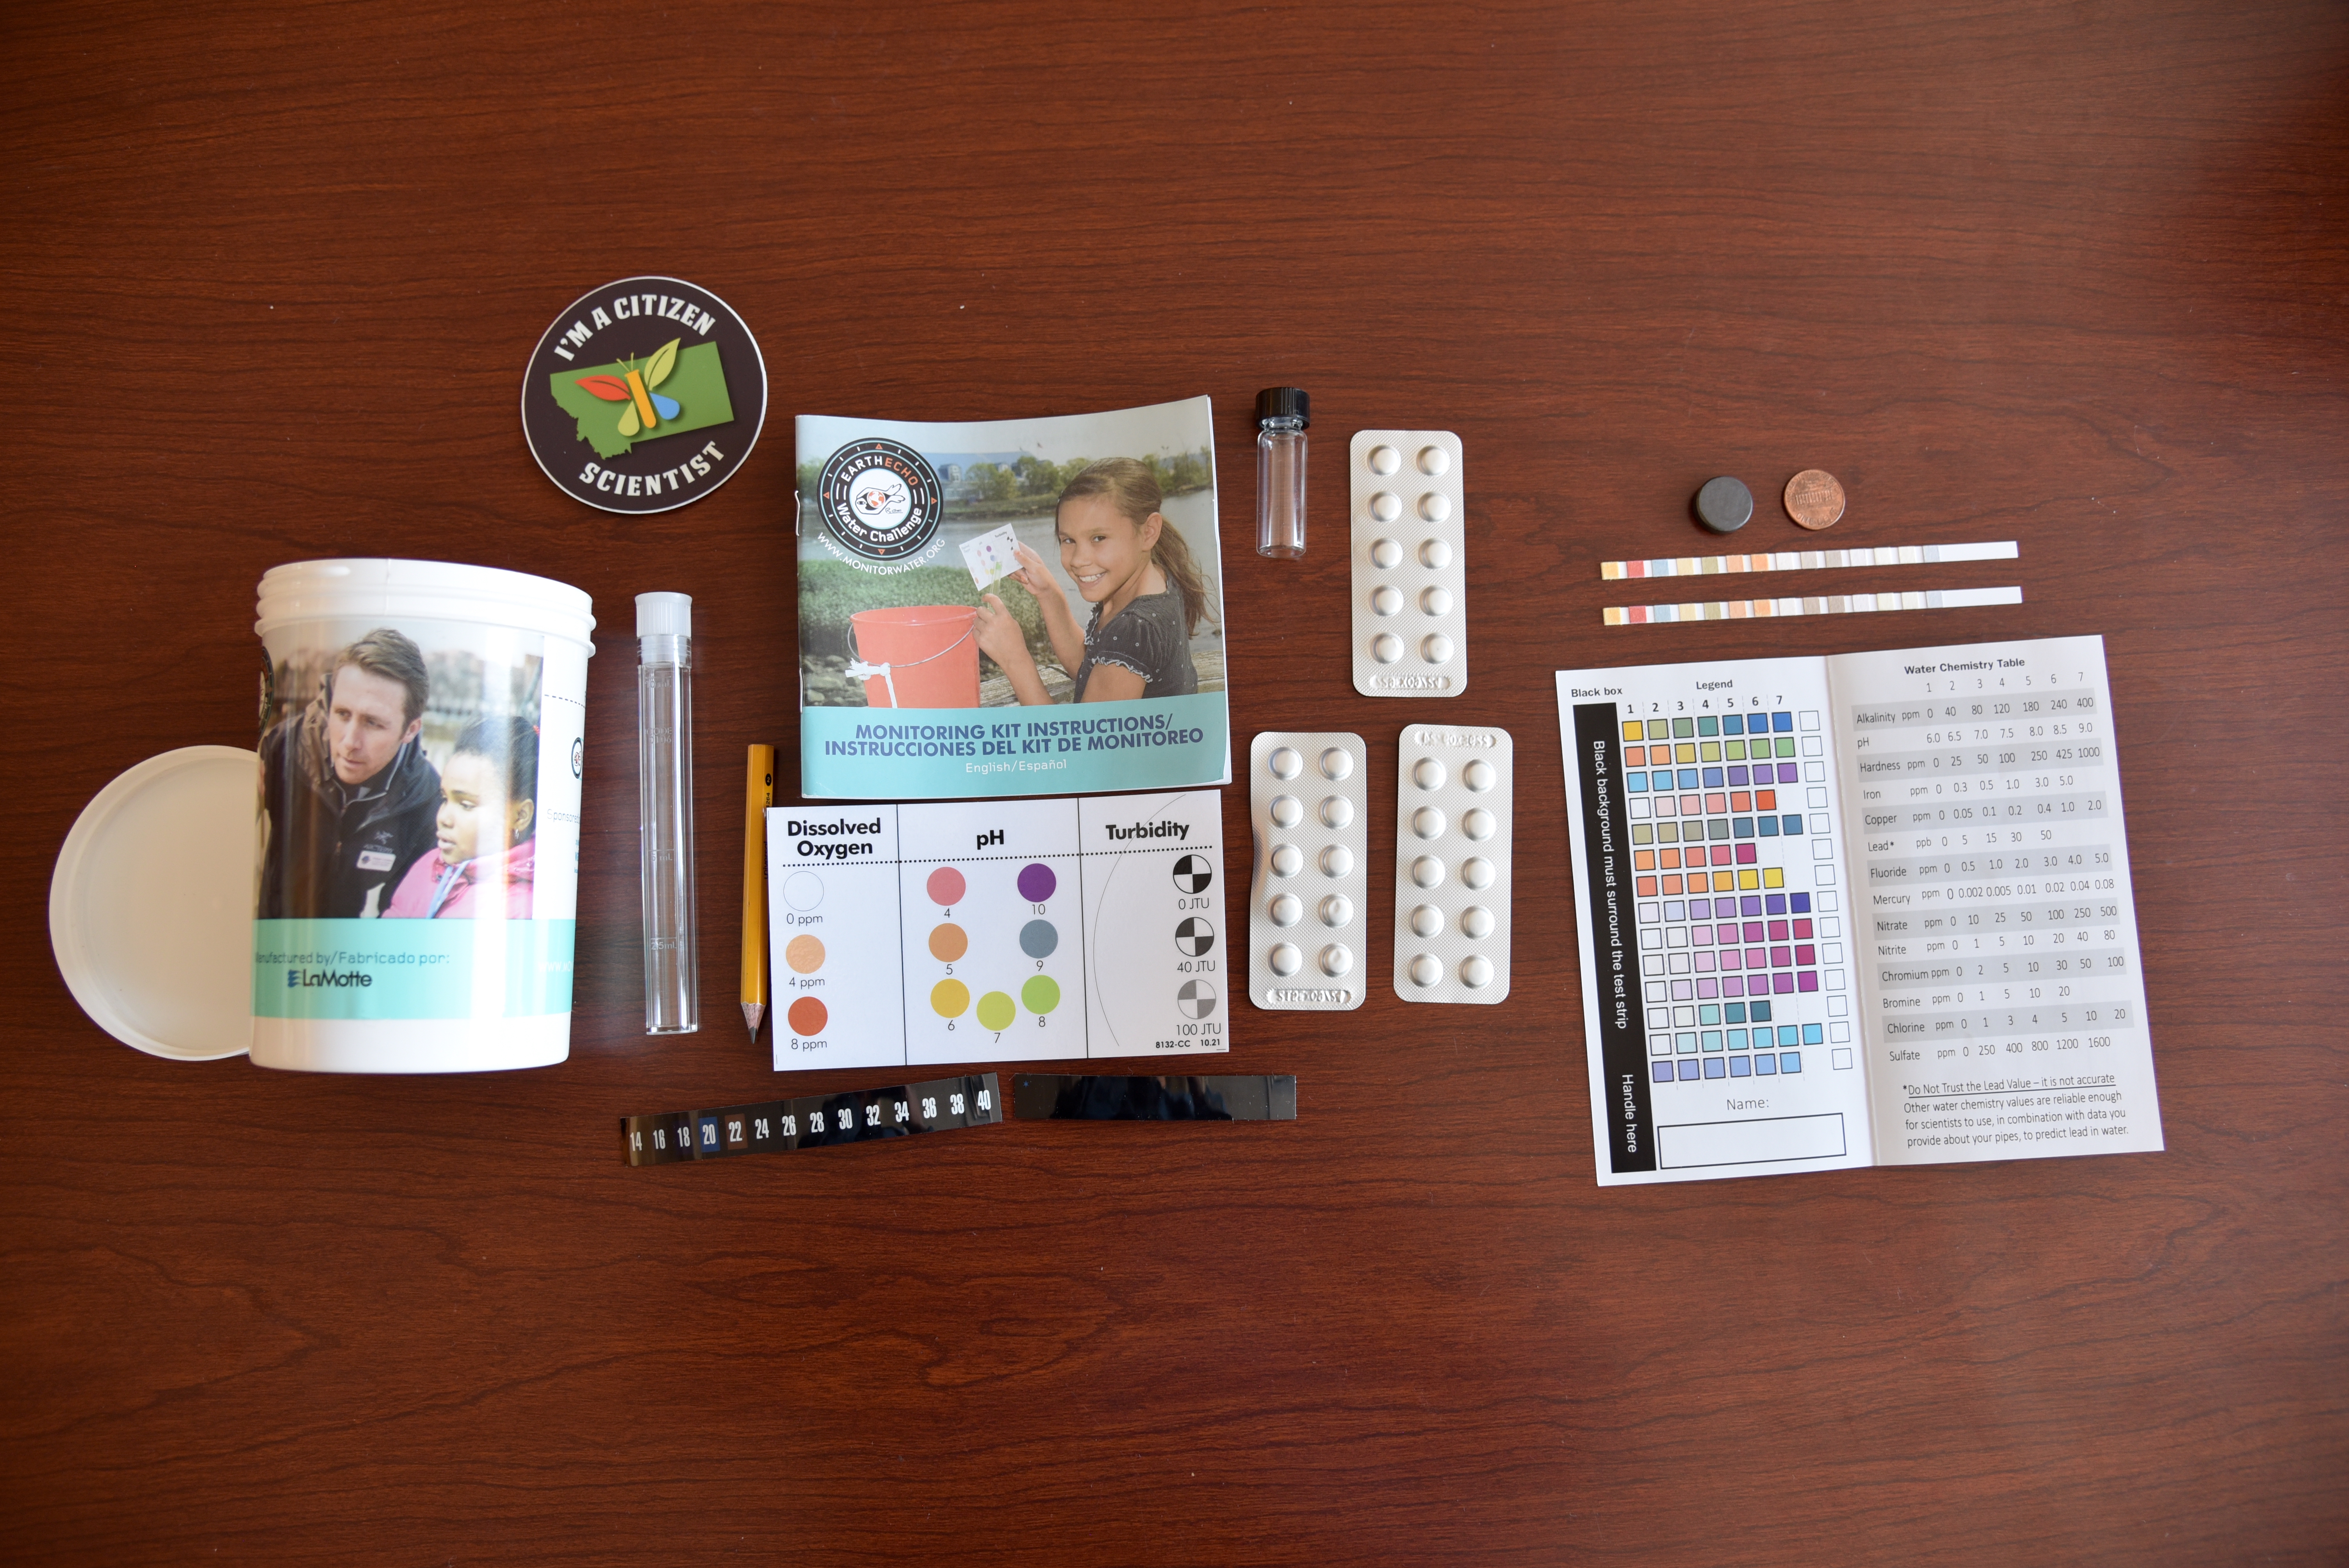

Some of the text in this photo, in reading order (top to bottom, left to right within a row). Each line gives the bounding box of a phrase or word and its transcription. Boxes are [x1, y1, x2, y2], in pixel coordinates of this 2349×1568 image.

[554, 294, 716, 361] I'M A CITIZEN
[579, 441, 724, 497] SCIENTIST
[836, 502, 922, 542] Water Challenge
[818, 532, 945, 576] WWW.MONITORWATER.ORG
[1904, 658, 2025, 674] Water Chemistry Table
[1571, 687, 1622, 697] Black box
[1696, 679, 1733, 691] Legend
[1627, 695, 1782, 714] 1 2 3 4 5 6 7
[1857, 697, 2094, 724] Alkalinity ppm 0 40 80 120 180 240 400
[855, 713, 1173, 740] MONITORING KIT INSTRUCTIONS/
[825, 728, 1204, 757] INSTRUCCIONES DEL KIT DE MONITOREO
[966, 759, 1066, 775] English/Español
[788, 817, 881, 836] Dissolved
[1105, 820, 1190, 841] Turbidity
[977, 829, 1004, 850] pH
[797, 840, 873, 860] Oxygen
[1594, 741, 1629, 1029] Black background must surround the test strip
[1873, 878, 2114, 905] Mercury ppm 0 0.002 0.005 0.01 0.02 0.04 0.08
[944, 908, 950, 918] 4
[1032, 903, 1046, 915] 10
[1178, 897, 1209, 910] 0 JTU
[786, 913, 823, 927] 0 ppm
[316, 951, 415, 966] by/Fabricado
[419, 954, 449, 967] por:
[1036, 960, 1043, 971] 9
[1177, 960, 1215, 973] 40 JTU
[302, 968, 372, 987] LaMotte
[946, 964, 953, 975] 5
[789, 976, 825, 990] 4 ppm
[948, 1019, 955, 1031] 6
[1039, 1016, 1046, 1027] 8
[1176, 1023, 1221, 1036] 100 JTU
[791, 1038, 827, 1052] 8 ppm
[994, 1032, 1001, 1044] 7
[1155, 1040, 1191, 1049] 8132-CC
[1923, 1084, 1940, 1094] Not
[1941, 1083, 1964, 1093] Trust
[1966, 1081, 1981, 1092] the
[1984, 1079, 2004, 1090] Lead
[2006, 1078, 2031, 1089] Value
[2041, 1077, 2048, 1087] it
[2050, 1076, 2057, 1087] is
[2059, 1076, 2075, 1086] not
[2077, 1074, 2115, 1085] accurate
[1727, 1099, 1769, 1110] Name:
[1904, 1090, 2122, 1113] Other water chemistry values are reliable enough
[630, 1089, 991, 1151] 14 16 18 20 22 24 26 28 30 32 34 36 38 40
[1622, 1074, 1638, 1153] Handle here
[1905, 1108, 2126, 1130] for scientists to use, in combination with data you
[1907, 1125, 2128, 1149] provide about your pipes, to predict lead in water.
